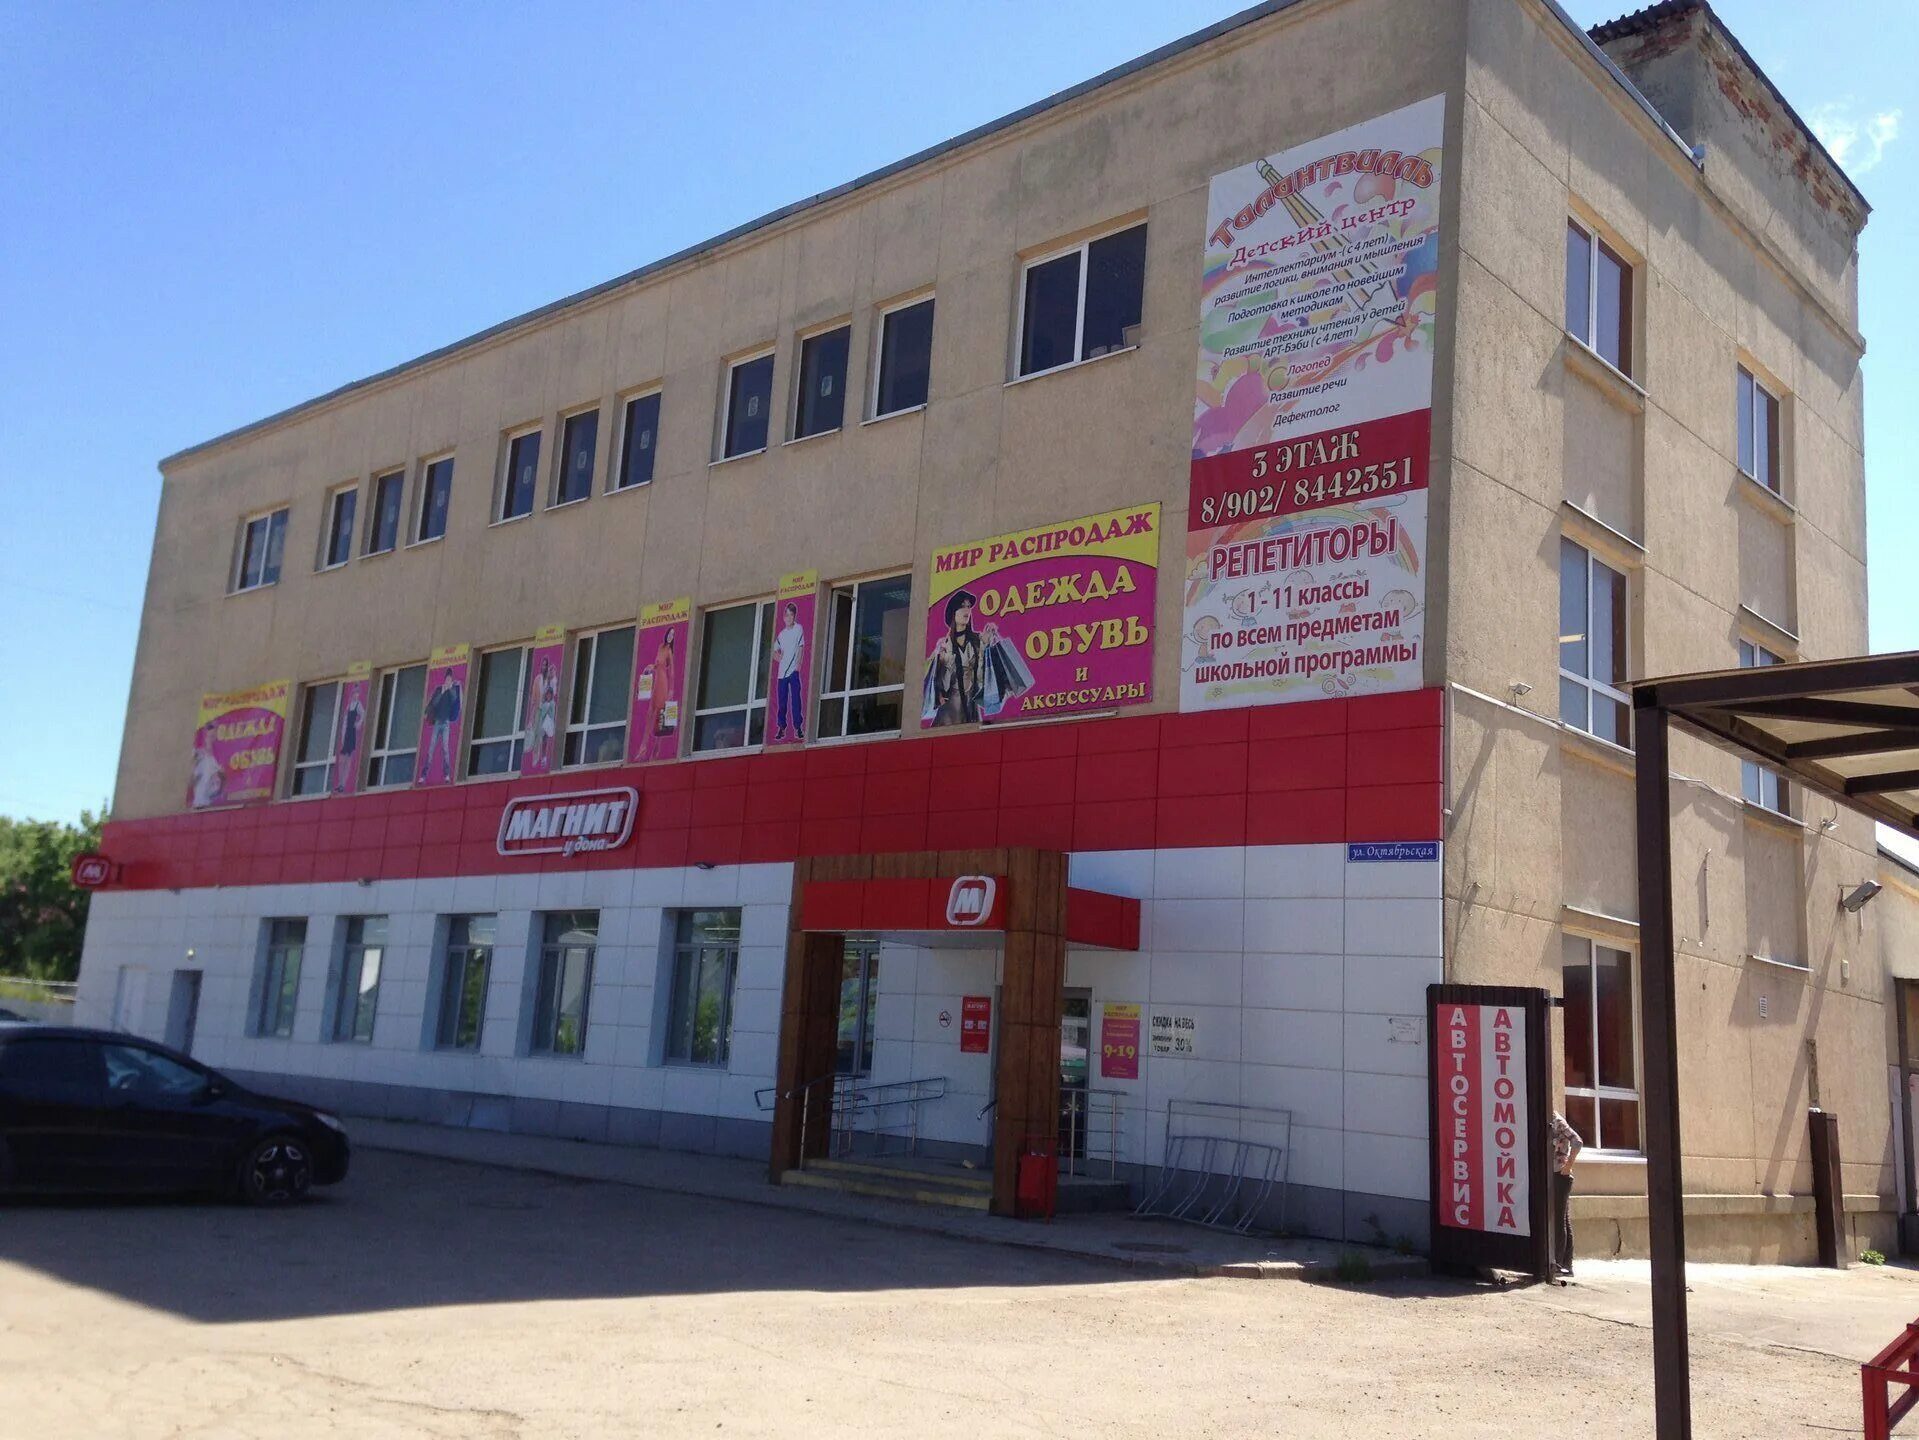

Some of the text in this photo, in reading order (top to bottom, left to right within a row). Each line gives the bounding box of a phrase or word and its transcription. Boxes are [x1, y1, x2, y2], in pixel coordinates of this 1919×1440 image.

[1230, 198, 1416, 266] Детский центр
[1214, 236, 1423, 307] развитие логики, внимания и мышления
[1244, 251, 1336, 284] Интеллектариум
[1227, 299, 1288, 323] Подготовка
[1297, 288, 1331, 303] школе
[1332, 283, 1346, 294] по
[1346, 266, 1404, 289] новейшим
[1280, 296, 1344, 319] методикам
[1223, 300, 1406, 357] Развитие техники чтения у детей
[1263, 340, 1309, 358] АРТ-Бэби
[1287, 356, 1331, 376] Логопед
[1270, 377, 1347, 403] Развитие речи
[1273, 403, 1340, 428] Дефектолог
[1253, 430, 1360, 478] 3 ЭТАЖ
[1201, 457, 1413, 523] 8/902/ 8442351
[936, 511, 1153, 573] МИР РАСПРОДАЖ
[1211, 518, 1397, 580] РЕПЕТИТОРЫ
[978, 565, 1137, 617] ОДЕЖДА
[1273, 586, 1292, 610] 11
[1299, 579, 1369, 604] классы
[1025, 616, 1149, 660] ОБУВЬ
[1211, 609, 1400, 650] по всем предметам
[1195, 643, 1417, 684] школьной программы
[1020, 682, 1145, 711] АКСЕССУАРЫ
[505, 801, 628, 840] МАГНИТ
[562, 836, 609, 857] у дома
[1352, 844, 1433, 860] ул. Октябрьская
[1104, 1044, 1135, 1060] 9-19
[1450, 1007, 1470, 1226] АВТОСЕРВИС
[1493, 1008, 1517, 1229] АВТОМОЙКА
